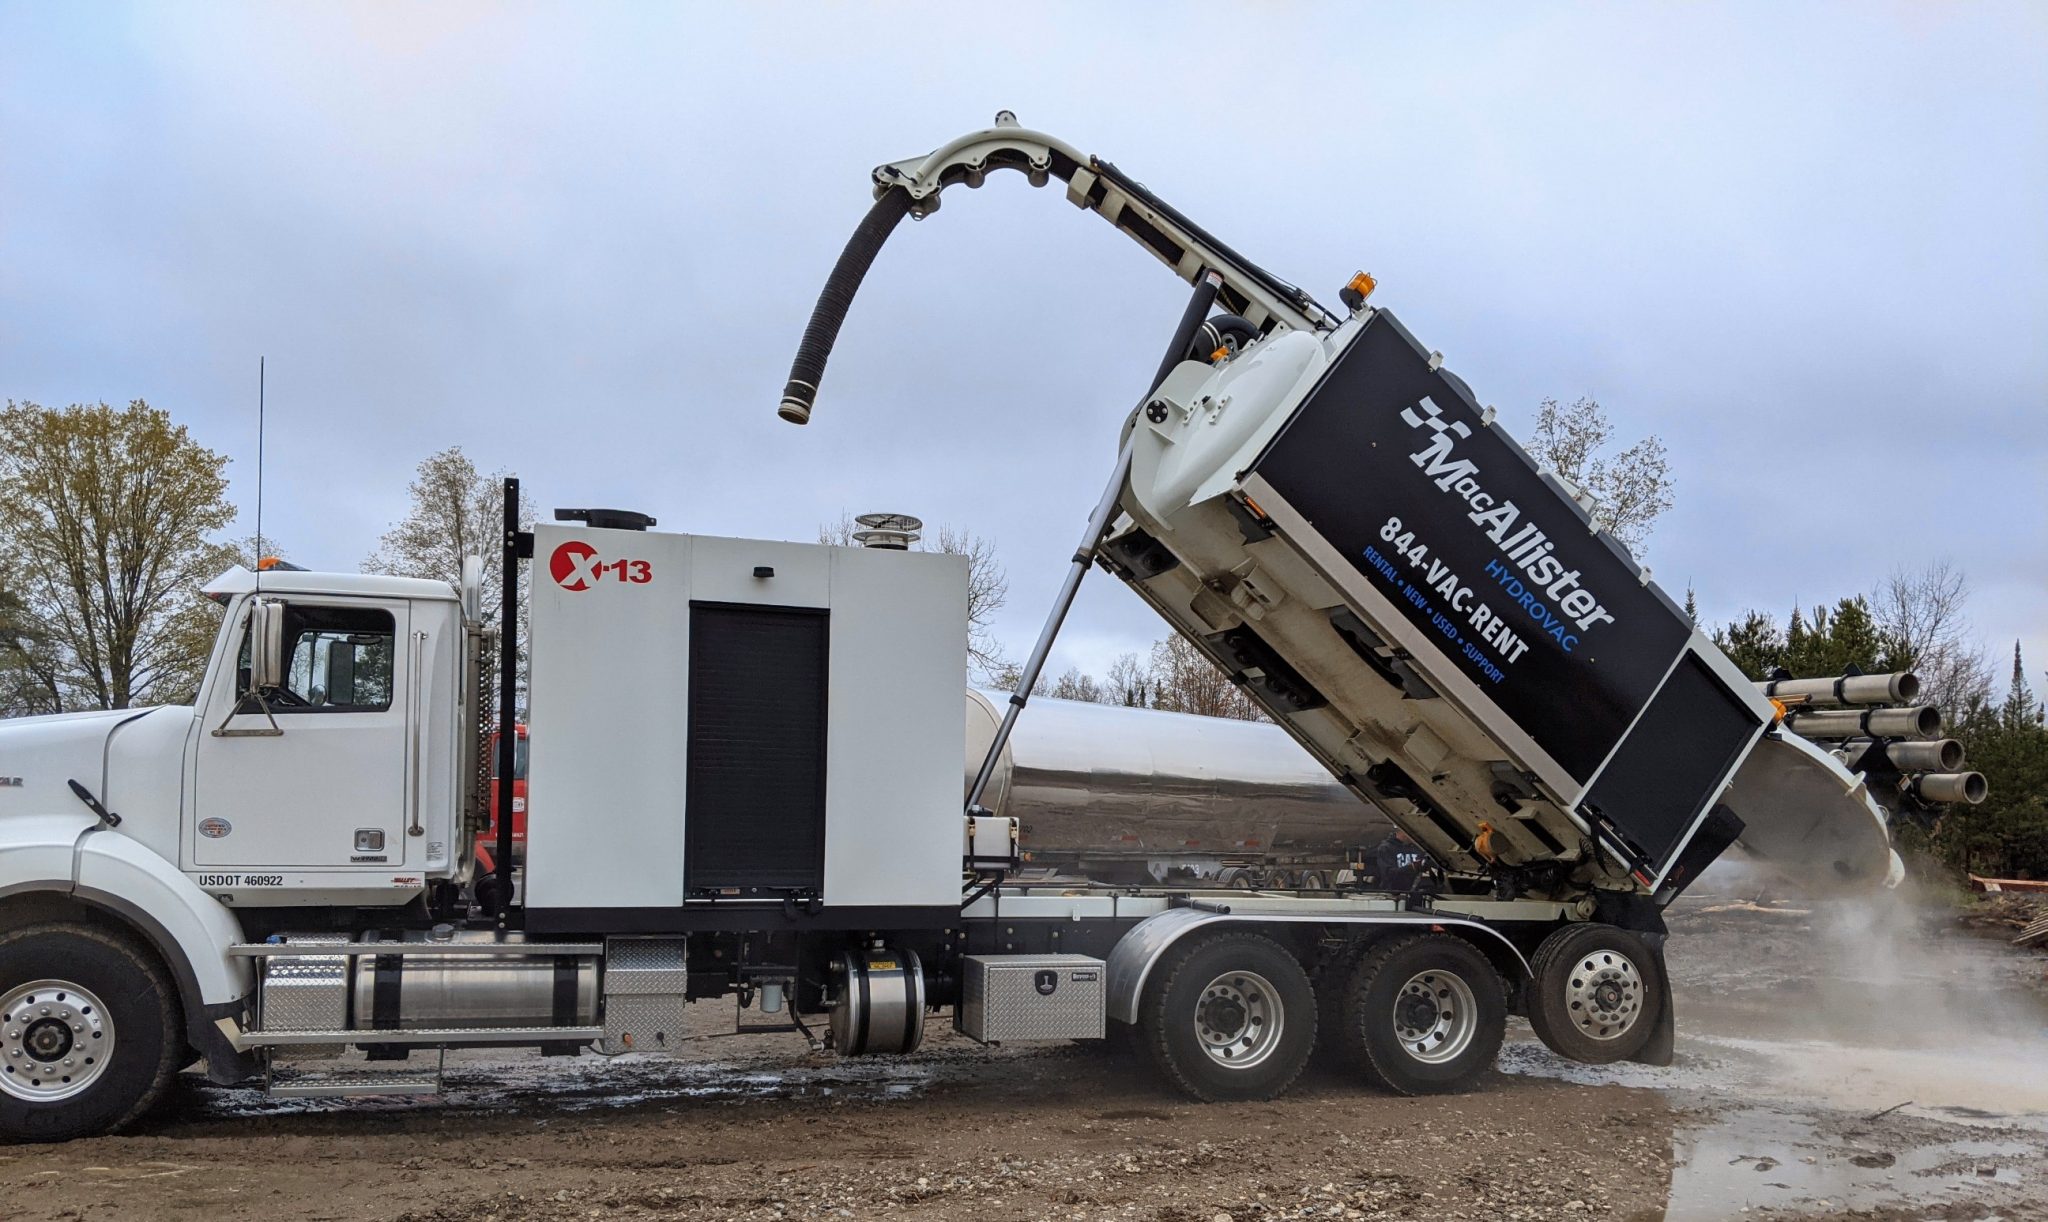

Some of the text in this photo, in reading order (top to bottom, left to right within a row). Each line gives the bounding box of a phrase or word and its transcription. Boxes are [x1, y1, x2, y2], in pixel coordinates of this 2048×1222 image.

[1380, 516, 1529, 664] 844-VAC-RENT
[1409, 431, 1615, 632] MacAllister
[1363, 545, 1505, 684] RENTAL NEW USED SUPPORT
[1485, 559, 1580, 652] HYDROVAC
[199, 875, 283, 886] USDOT 460922
